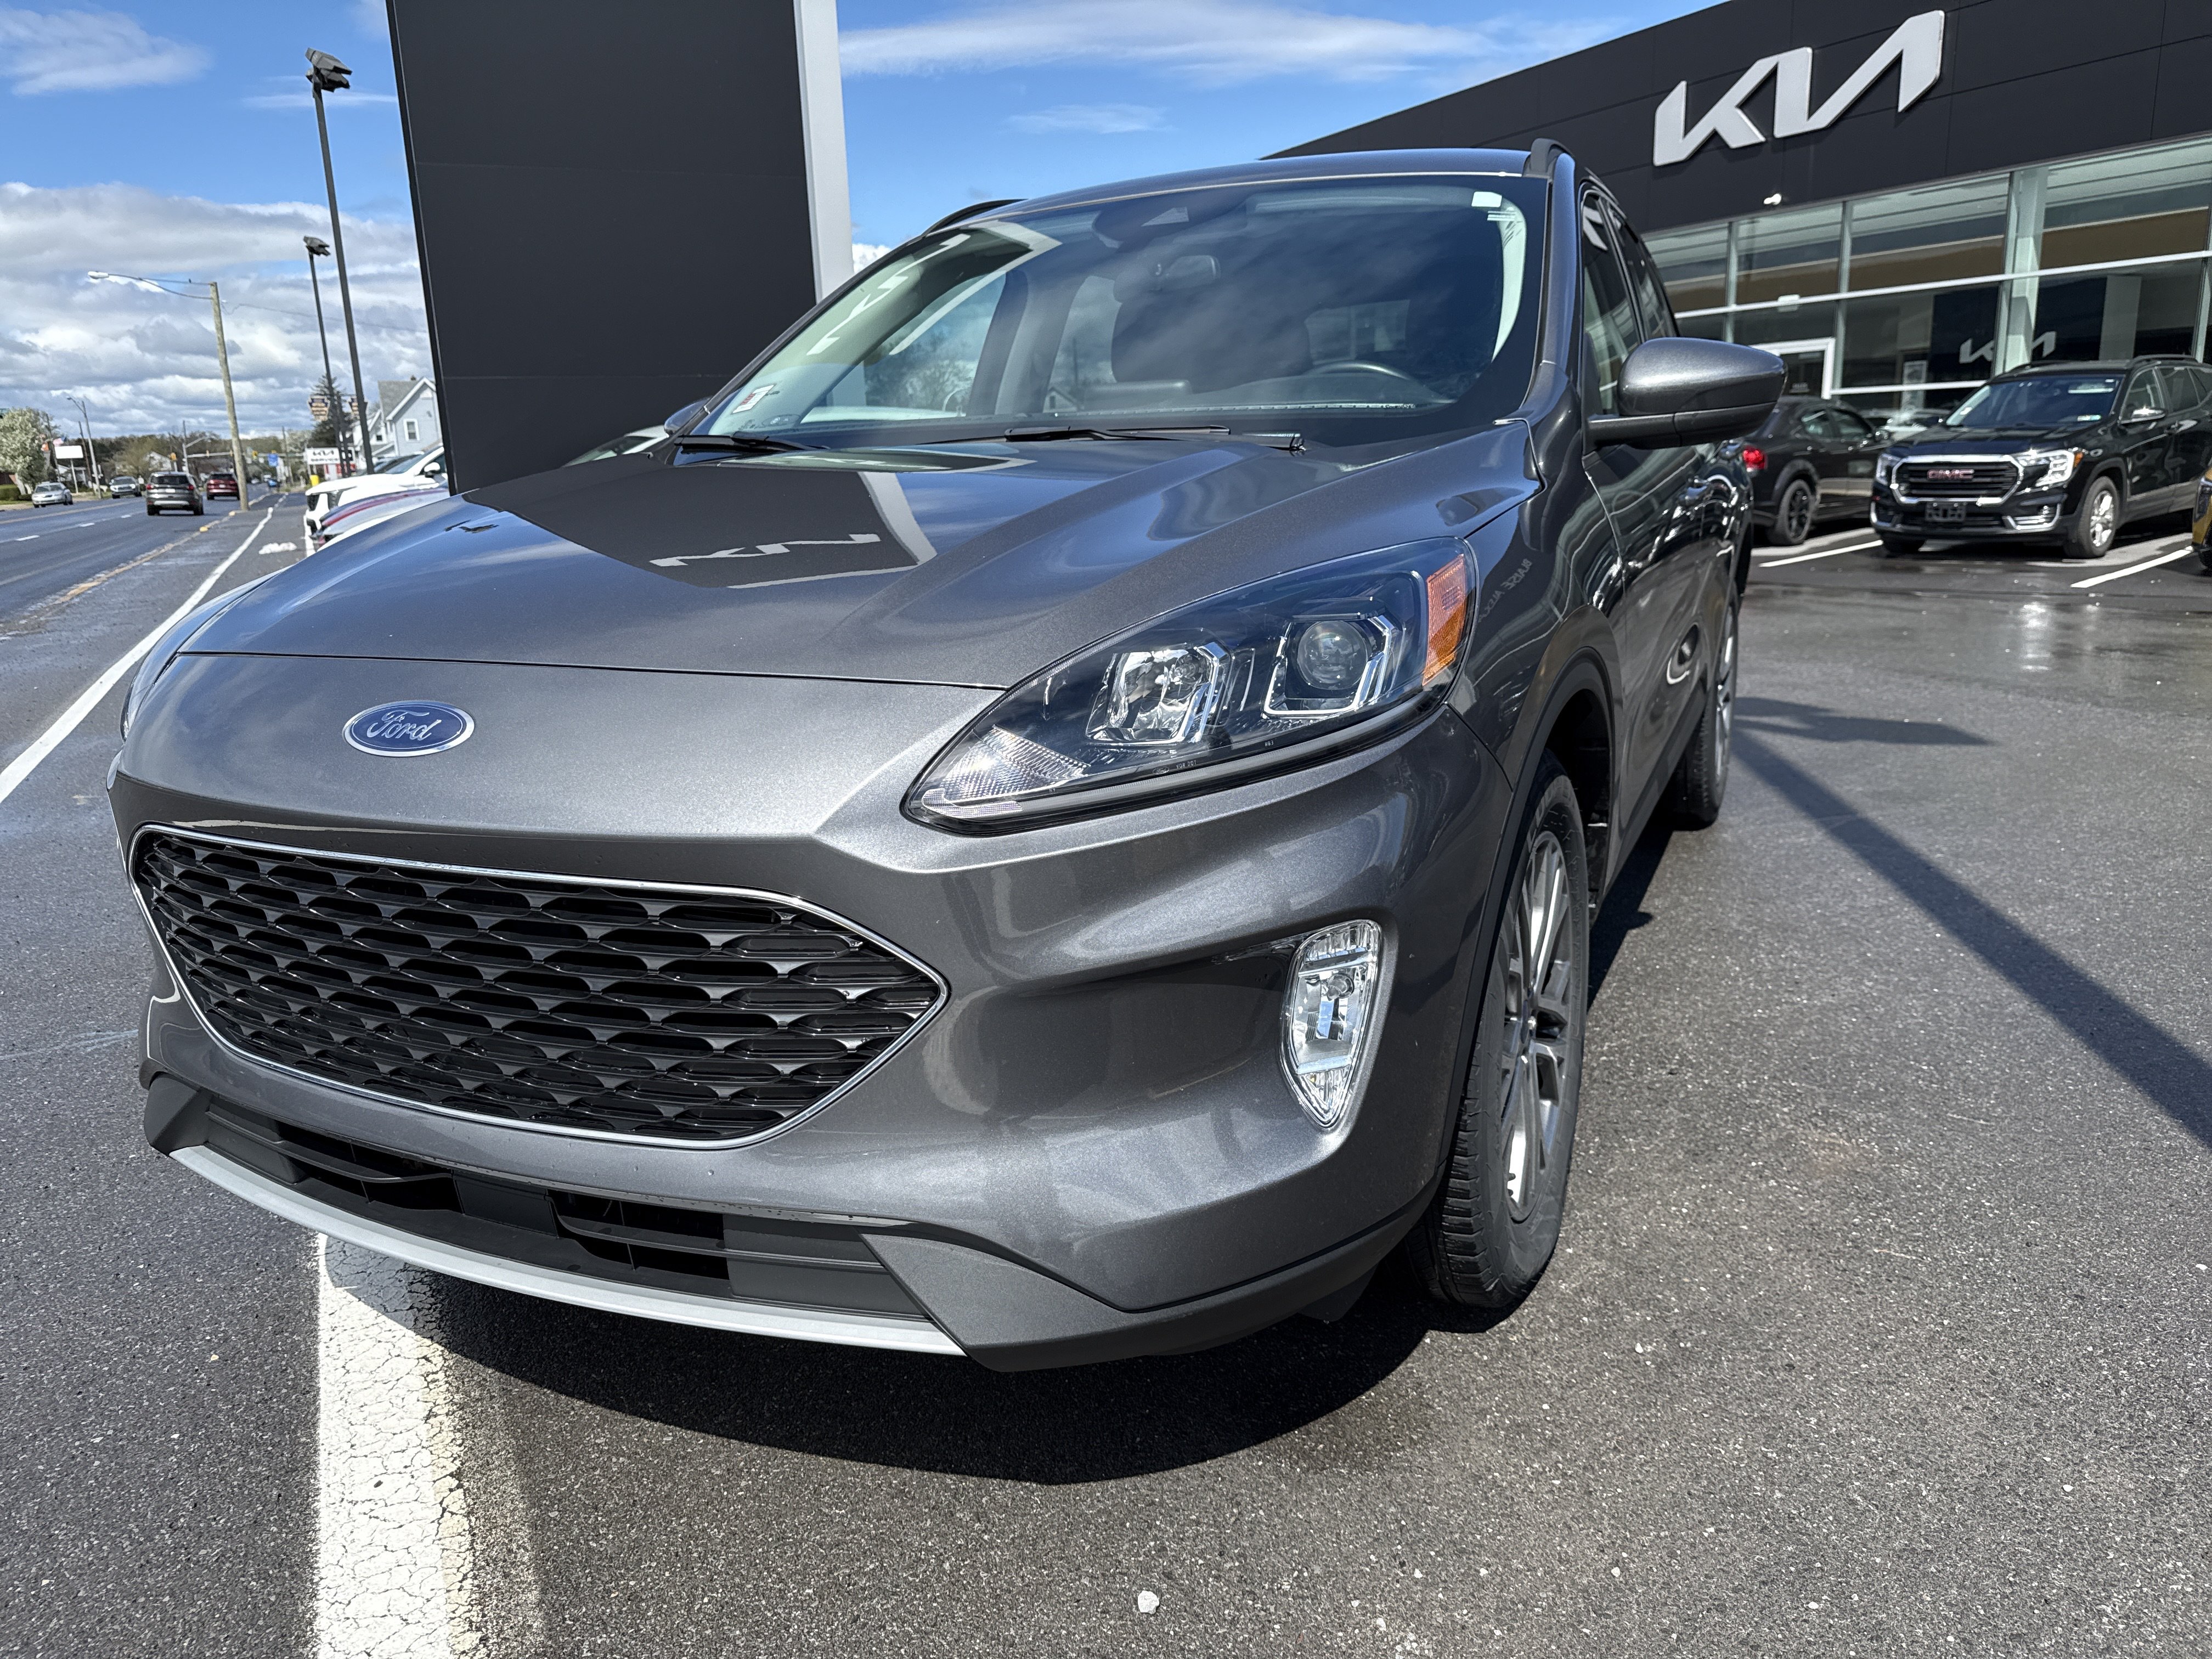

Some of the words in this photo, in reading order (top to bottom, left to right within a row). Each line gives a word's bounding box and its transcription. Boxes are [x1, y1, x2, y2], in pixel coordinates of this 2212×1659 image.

[1653, 10, 1945, 167] KIA
[1927, 469, 1974, 479] GMC
[366, 709, 442, 742] Ford
